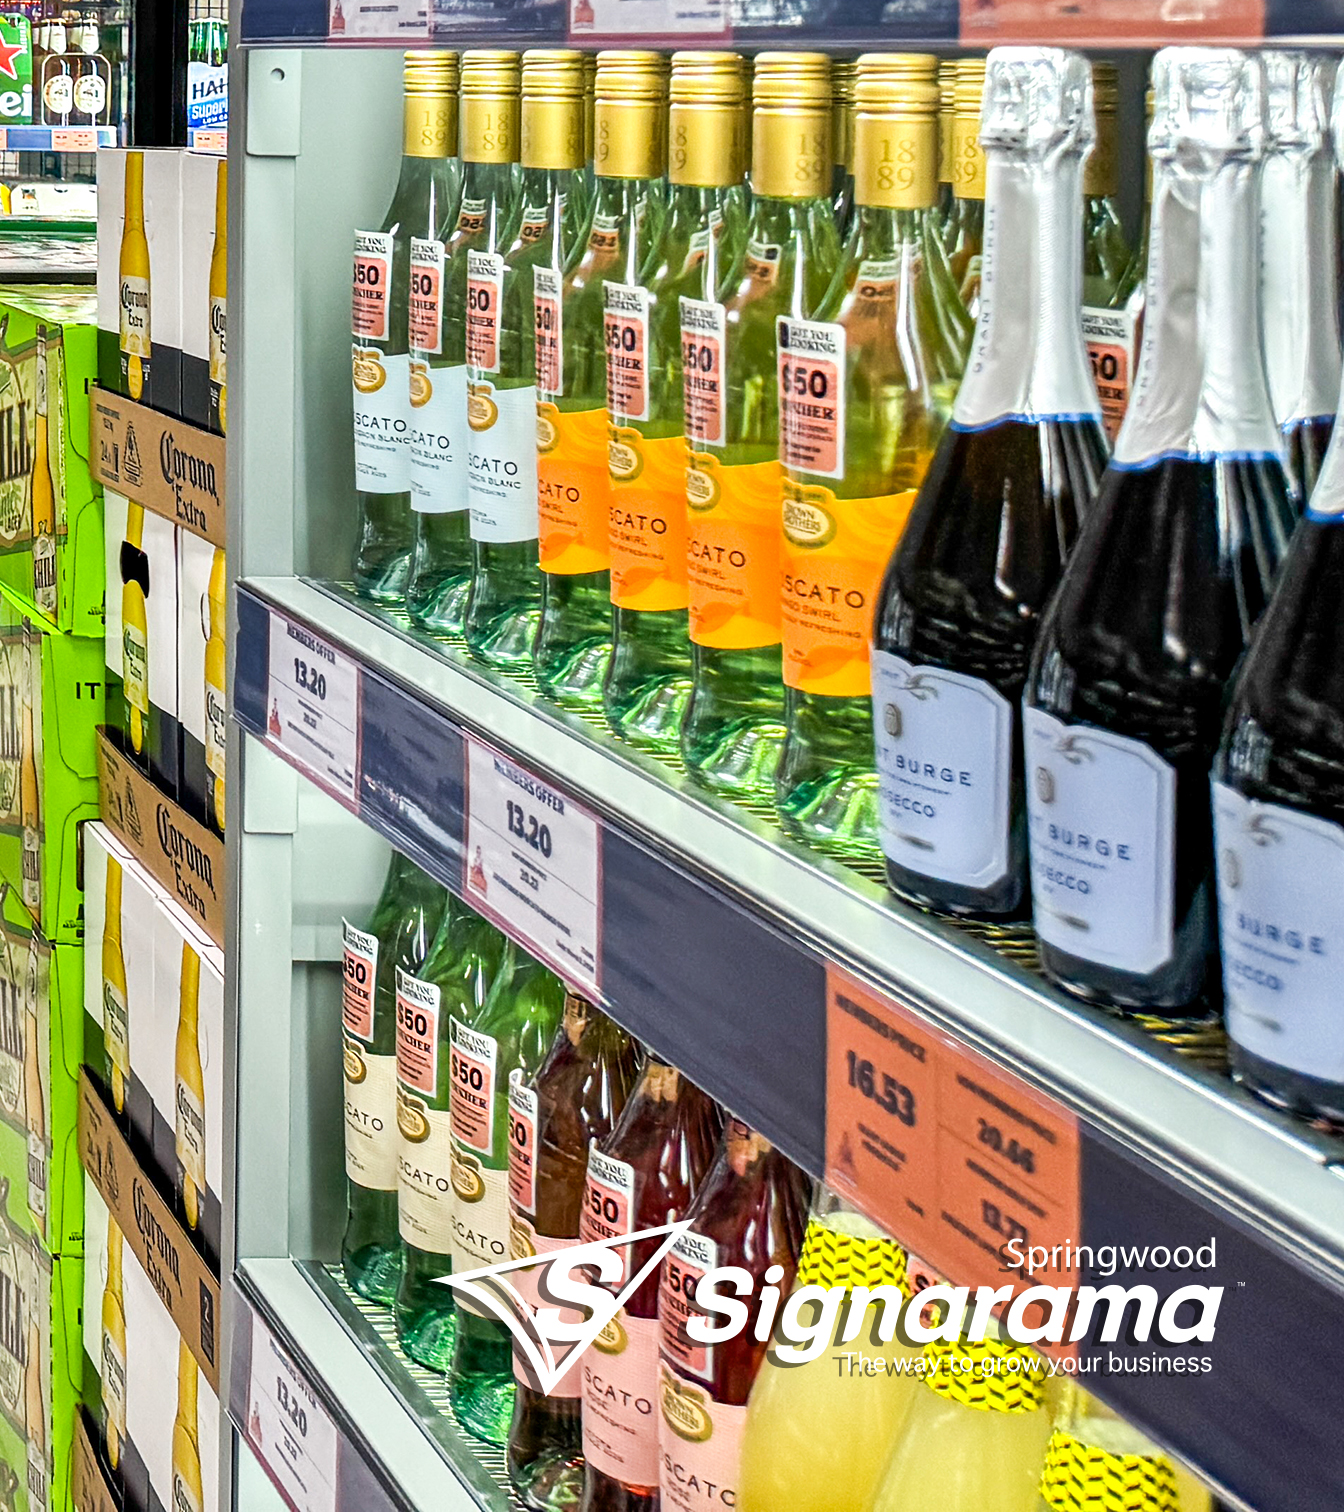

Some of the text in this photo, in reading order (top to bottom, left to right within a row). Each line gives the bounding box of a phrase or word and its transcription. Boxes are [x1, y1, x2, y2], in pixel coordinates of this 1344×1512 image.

[120, 281, 149, 310] Corona
[175, 484, 207, 534] Extra
[293, 656, 327, 701] 13.20
[895, 754, 972, 787] BURGE
[506, 799, 553, 859] 13.20
[1047, 823, 1132, 862] BURGE
[846, 1046, 916, 1128] 16.53
